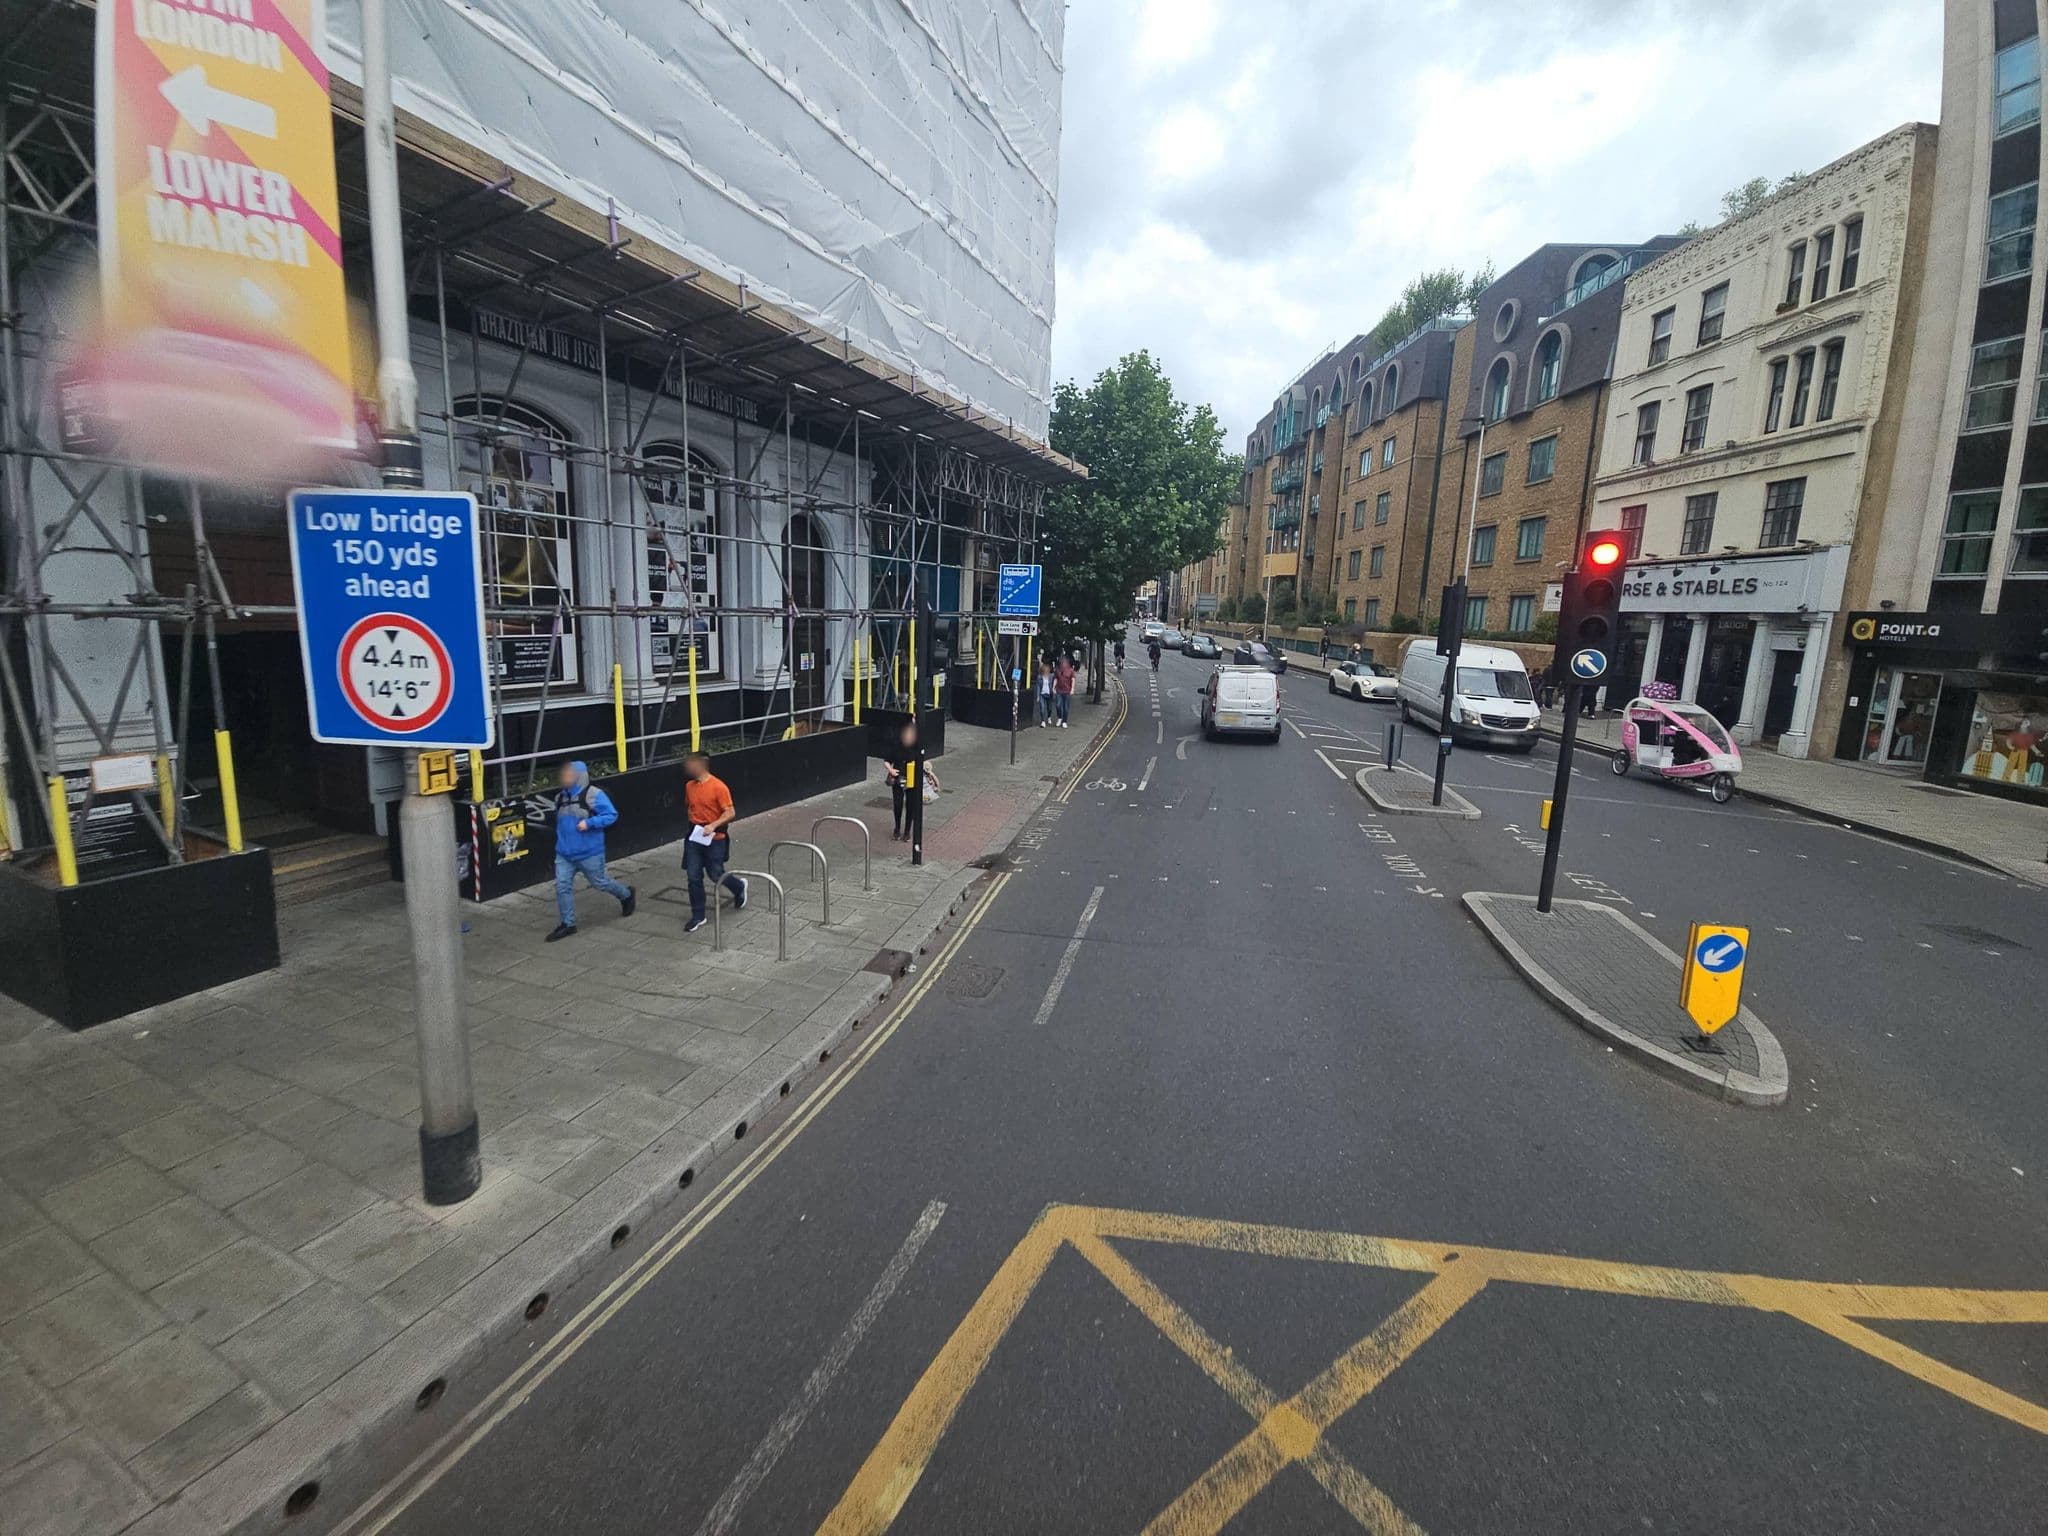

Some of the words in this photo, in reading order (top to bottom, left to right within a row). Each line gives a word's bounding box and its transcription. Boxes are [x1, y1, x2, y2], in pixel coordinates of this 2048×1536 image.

[133, 0, 284, 73] LONDON
[147, 145, 298, 220] LOWER
[144, 193, 310, 268] MARSH
[305, 505, 361, 532] Low
[370, 507, 463, 540] bridge
[332, 539, 385, 566] 150
[388, 541, 438, 571] yds
[345, 572, 431, 599] ahead
[1622, 582, 1653, 597] RSE
[1656, 581, 1668, 596] &
[1672, 578, 1758, 597] STABLES
[362, 645, 405, 668] 4.4
[409, 654, 429, 669] m
[1358, 823, 1396, 844] LEFT
[1381, 854, 1427, 878] LOOK
[1562, 872, 1634, 905] LEFT
